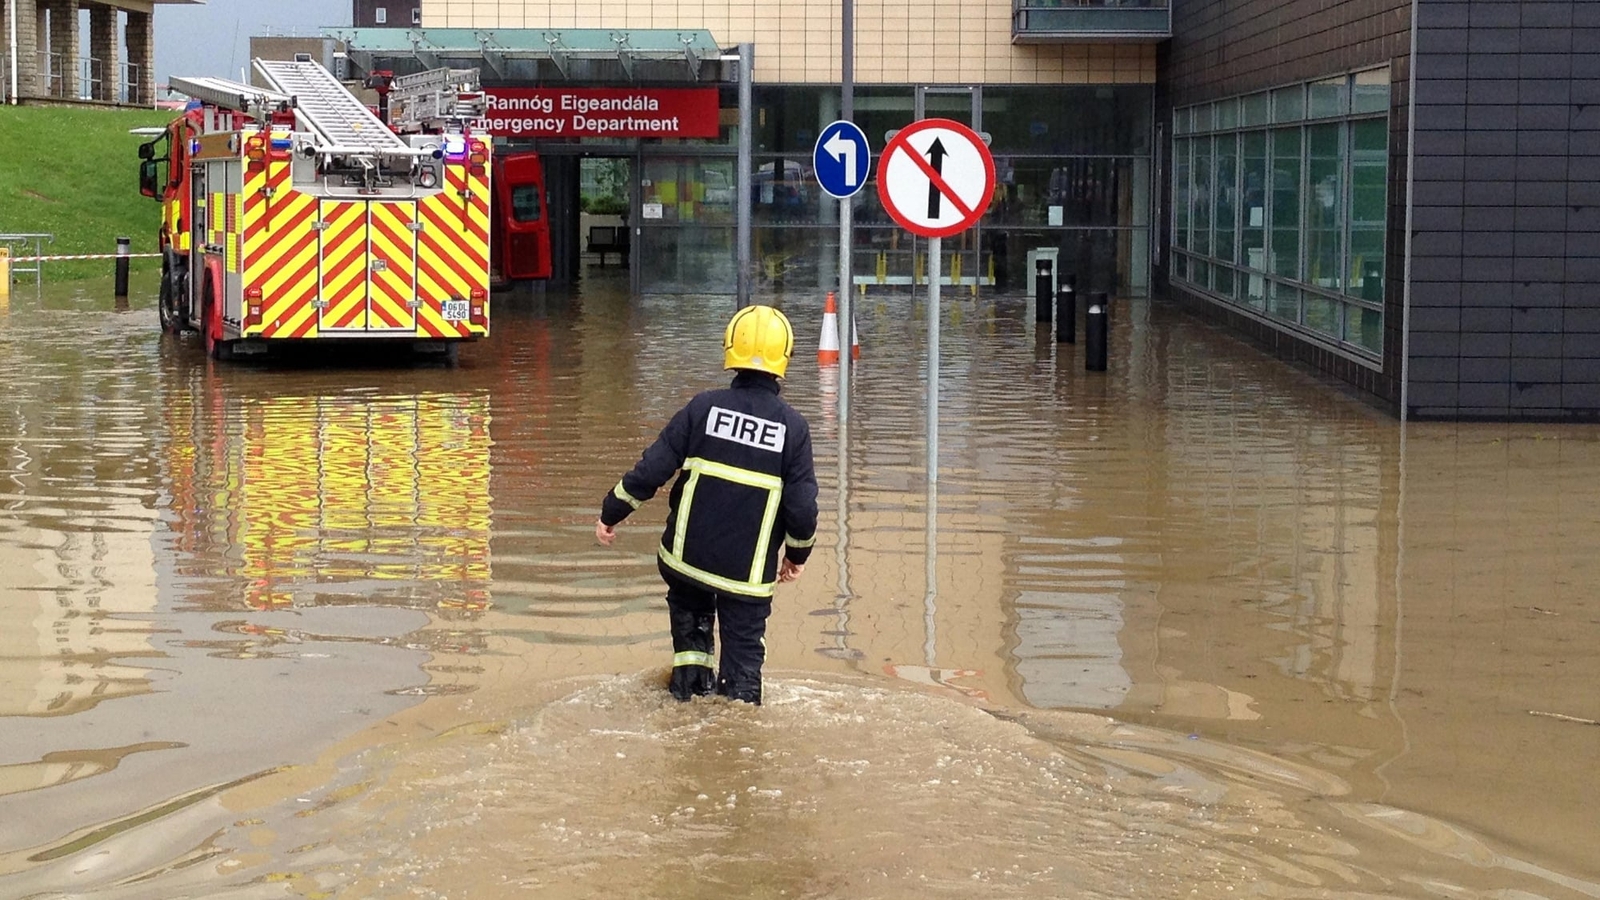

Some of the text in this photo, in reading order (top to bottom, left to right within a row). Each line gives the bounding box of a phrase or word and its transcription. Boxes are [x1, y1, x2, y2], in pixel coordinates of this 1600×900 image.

[486, 94, 659, 112] Rannóg Eigeandála
[573, 116, 679, 132] Department
[713, 412, 779, 447] FIRE
